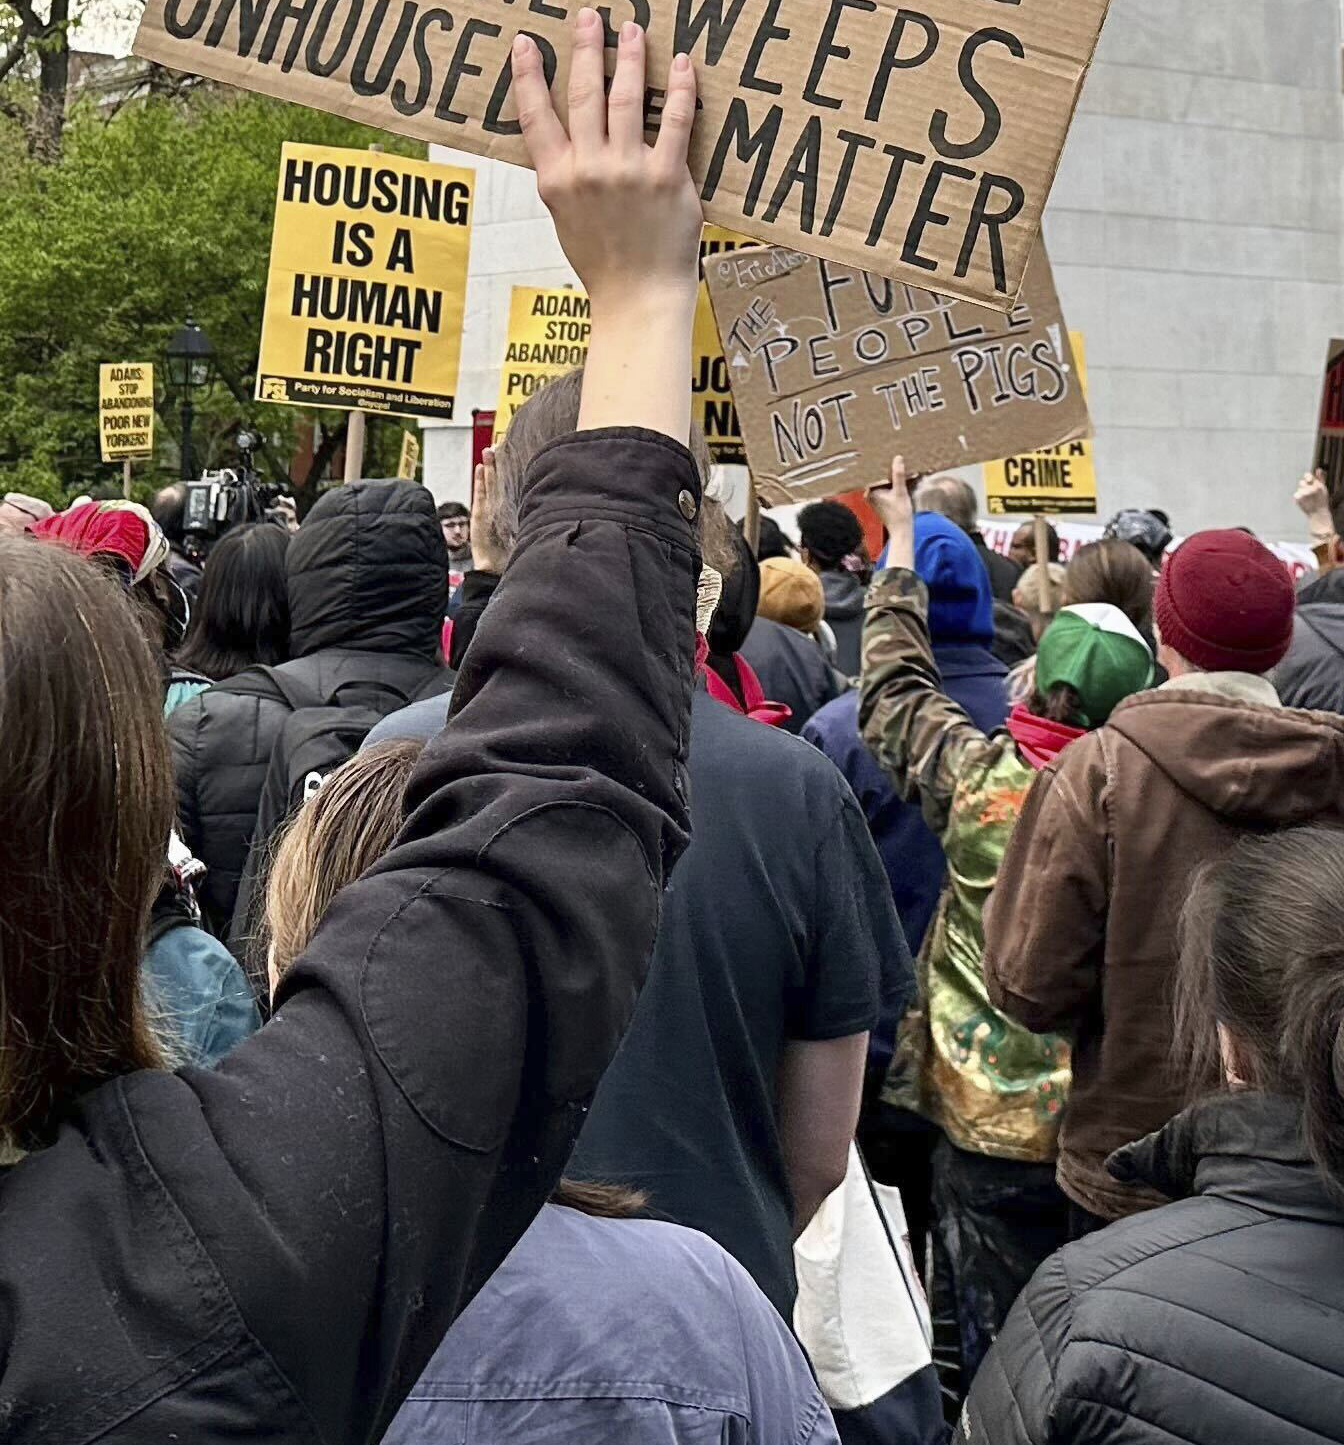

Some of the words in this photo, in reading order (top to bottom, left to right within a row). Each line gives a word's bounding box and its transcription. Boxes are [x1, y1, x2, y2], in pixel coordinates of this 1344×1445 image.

[283, 158, 470, 226] HOUSING
[700, 96, 1025, 294] MATTER
[331, 220, 375, 267] IS
[385, 228, 414, 274] A
[291, 273, 442, 334] HUMAN
[544, 321, 591, 342] STOP
[727, 295, 777, 355] THE
[304, 327, 422, 384] RIGHT
[756, 304, 1034, 393] PEOPLE
[262, 383, 290, 401] PSL
[294, 382, 320, 395] Party
[322, 385, 337, 395] for
[338, 386, 385, 400] Socialism
[386, 393, 403, 402] and
[405, 395, 452, 409] Liberation
[507, 373, 560, 396] POO
[771, 391, 856, 465] NOT
[873, 366, 946, 430] THE
[952, 323, 1070, 414] PIGS!
[103, 415, 131, 430] POOR
[132, 415, 150, 428] NEW
[1004, 458, 1073, 488] CRIME
